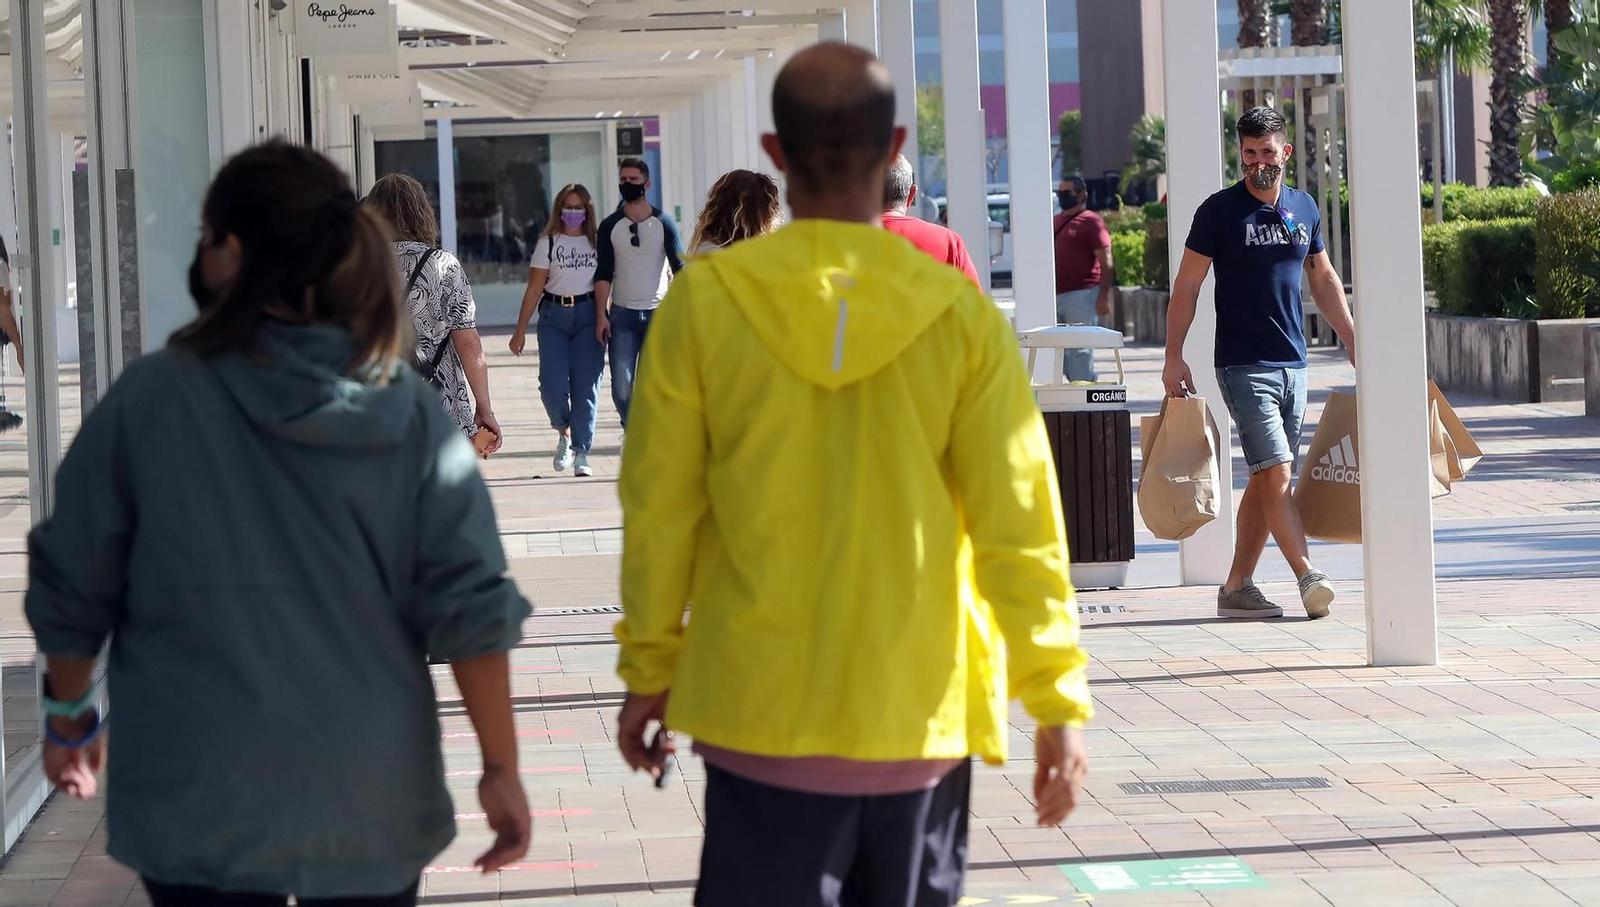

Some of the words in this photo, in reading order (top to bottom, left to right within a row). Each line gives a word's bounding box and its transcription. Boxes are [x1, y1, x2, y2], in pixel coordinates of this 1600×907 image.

[308, 2, 338, 22] Pepe
[338, 3, 376, 22] Jeans
[1245, 222, 1309, 246] ADIDS
[1311, 463, 1361, 485] adidas
